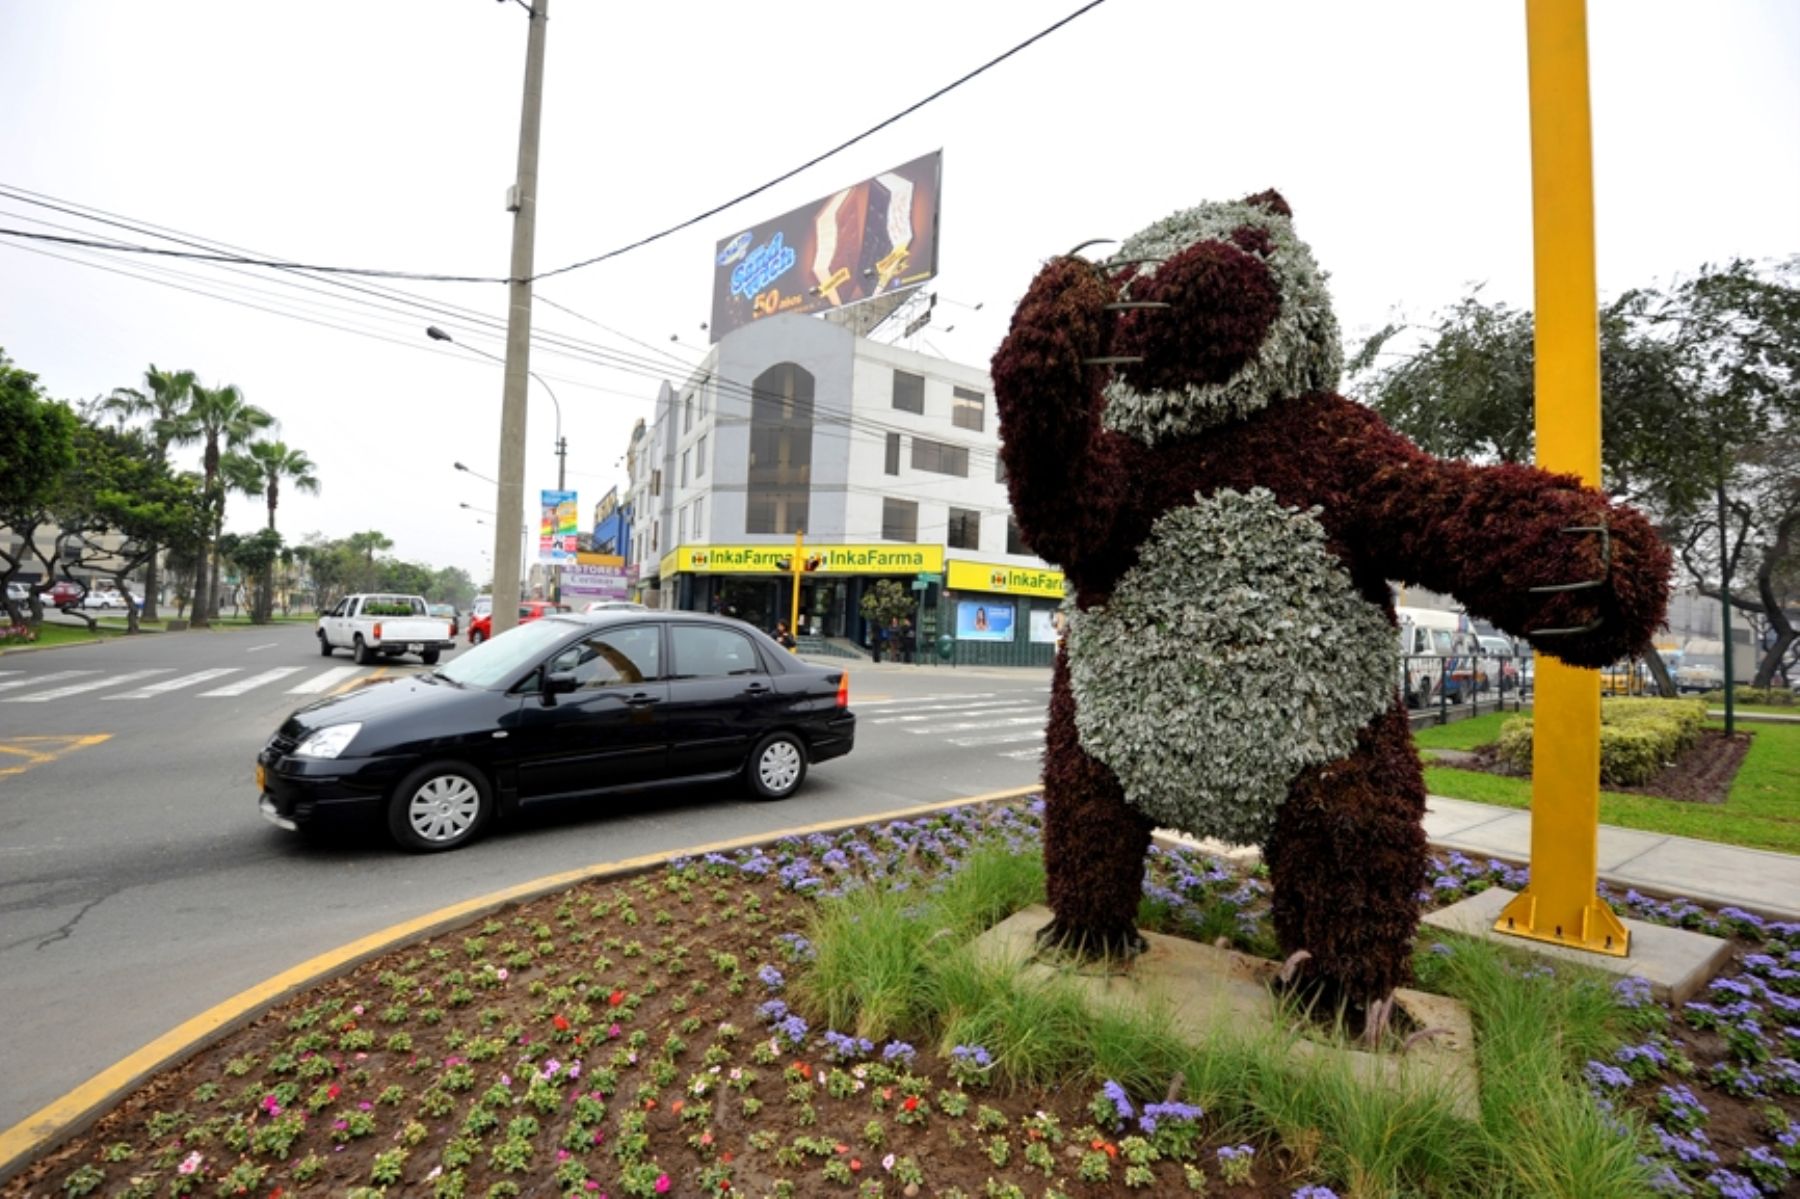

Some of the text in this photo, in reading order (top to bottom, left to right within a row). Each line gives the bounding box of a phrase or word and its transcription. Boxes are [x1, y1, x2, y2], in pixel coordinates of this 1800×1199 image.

[752, 288, 780, 319] 50
[830, 549, 923, 566] InkaFarma
[1009, 570, 1063, 590] InkaFar
